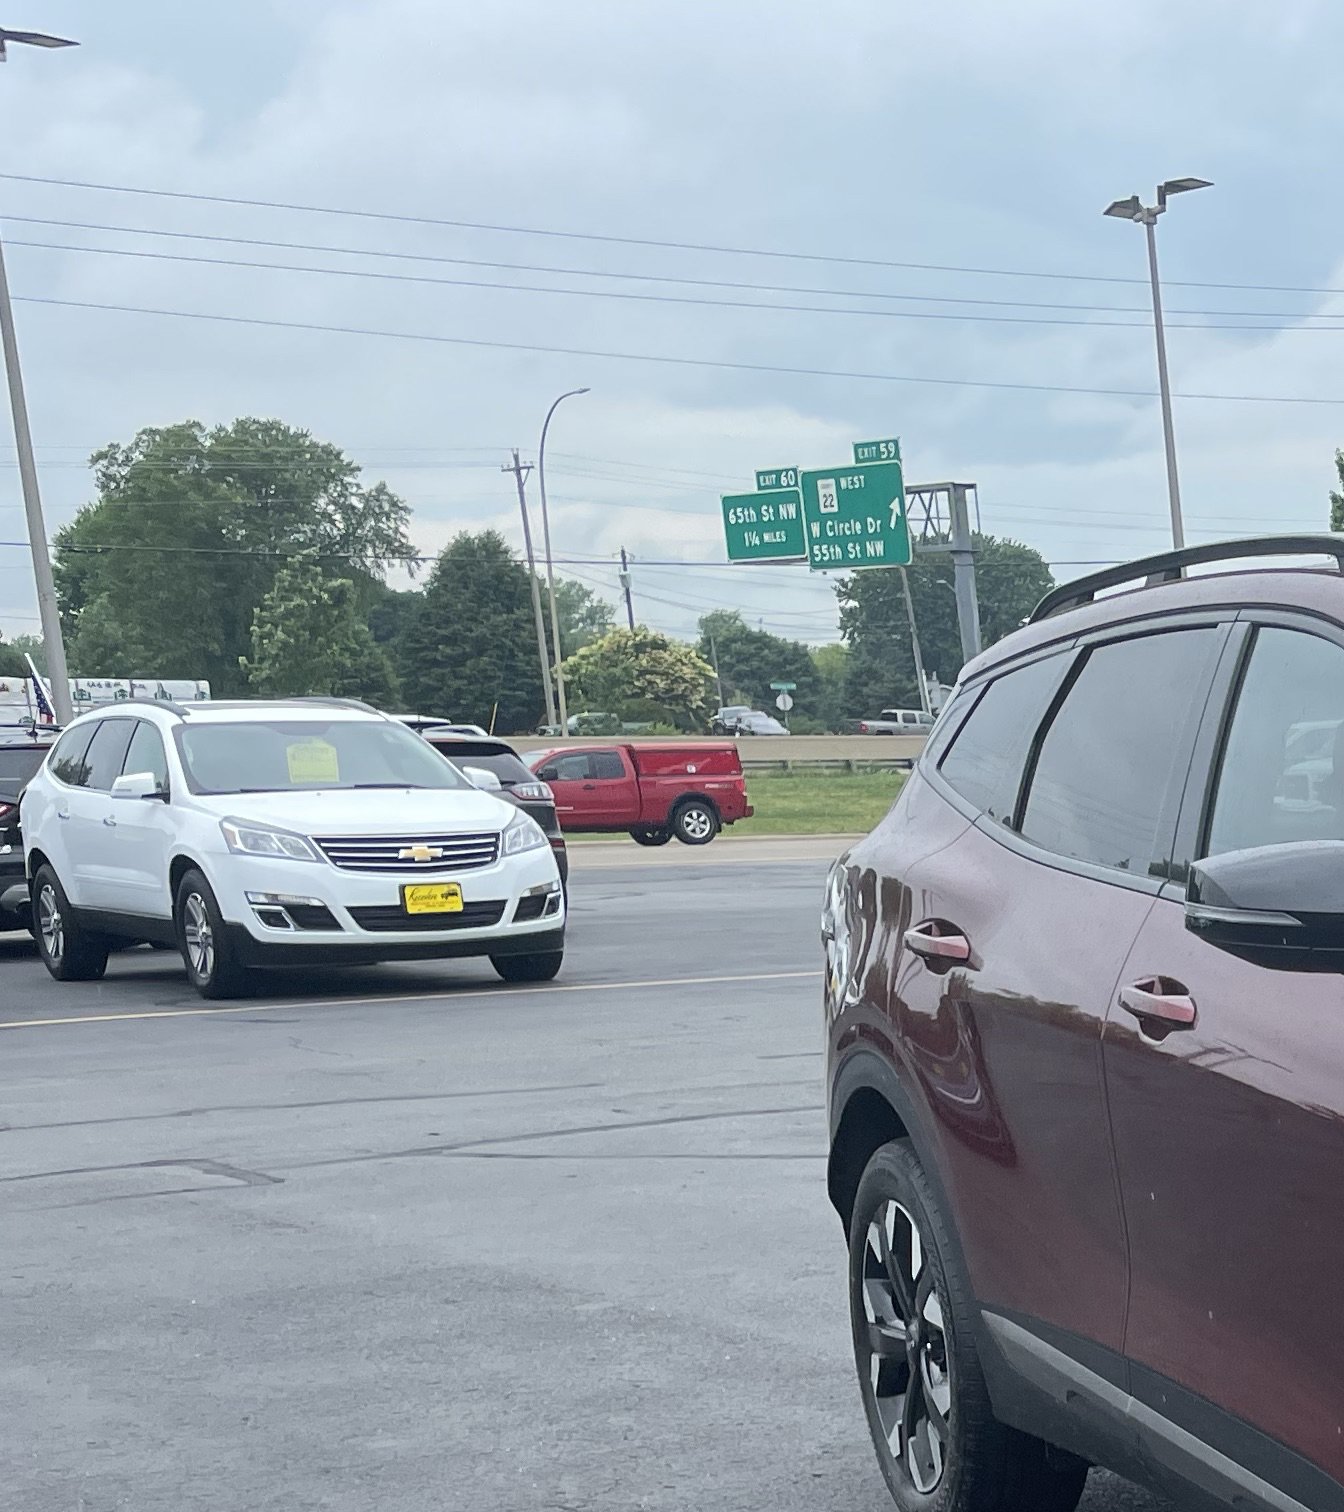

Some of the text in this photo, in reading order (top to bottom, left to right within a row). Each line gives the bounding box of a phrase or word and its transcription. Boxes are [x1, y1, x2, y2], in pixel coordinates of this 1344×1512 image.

[857, 442, 895, 459] EXIT 59
[759, 470, 795, 487] EXIT 60
[840, 475, 865, 490] WEST
[823, 494, 834, 509] 22
[728, 503, 796, 524] 65th St NW
[811, 516, 881, 539] W Circle Dr
[763, 530, 787, 543] MILES
[813, 540, 884, 562] 55th St NW
